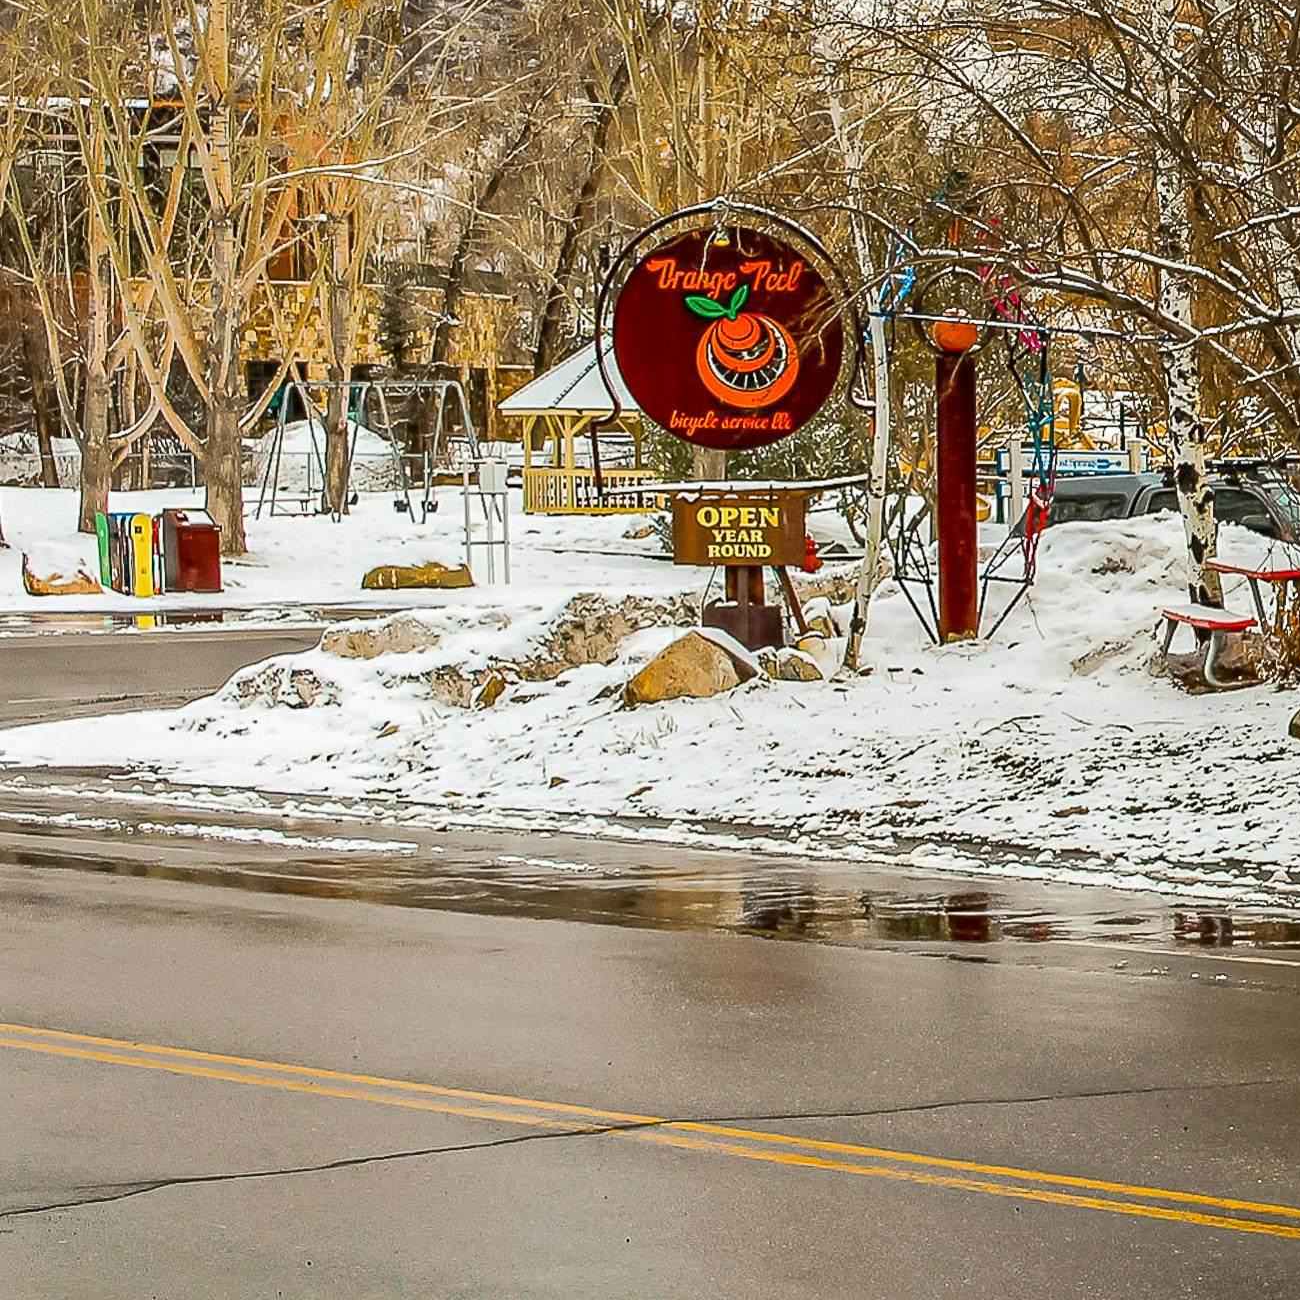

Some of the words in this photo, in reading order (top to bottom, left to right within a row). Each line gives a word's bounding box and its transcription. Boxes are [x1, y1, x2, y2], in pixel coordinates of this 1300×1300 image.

[646, 259, 737, 300] Orange
[739, 261, 803, 291] Peel
[670, 410, 719, 436] bicycle
[721, 417, 769, 429] service
[771, 411, 791, 430] llc
[696, 506, 780, 528] OPEN
[712, 529, 763, 543] YEAR
[707, 543, 772, 558] ROUND
